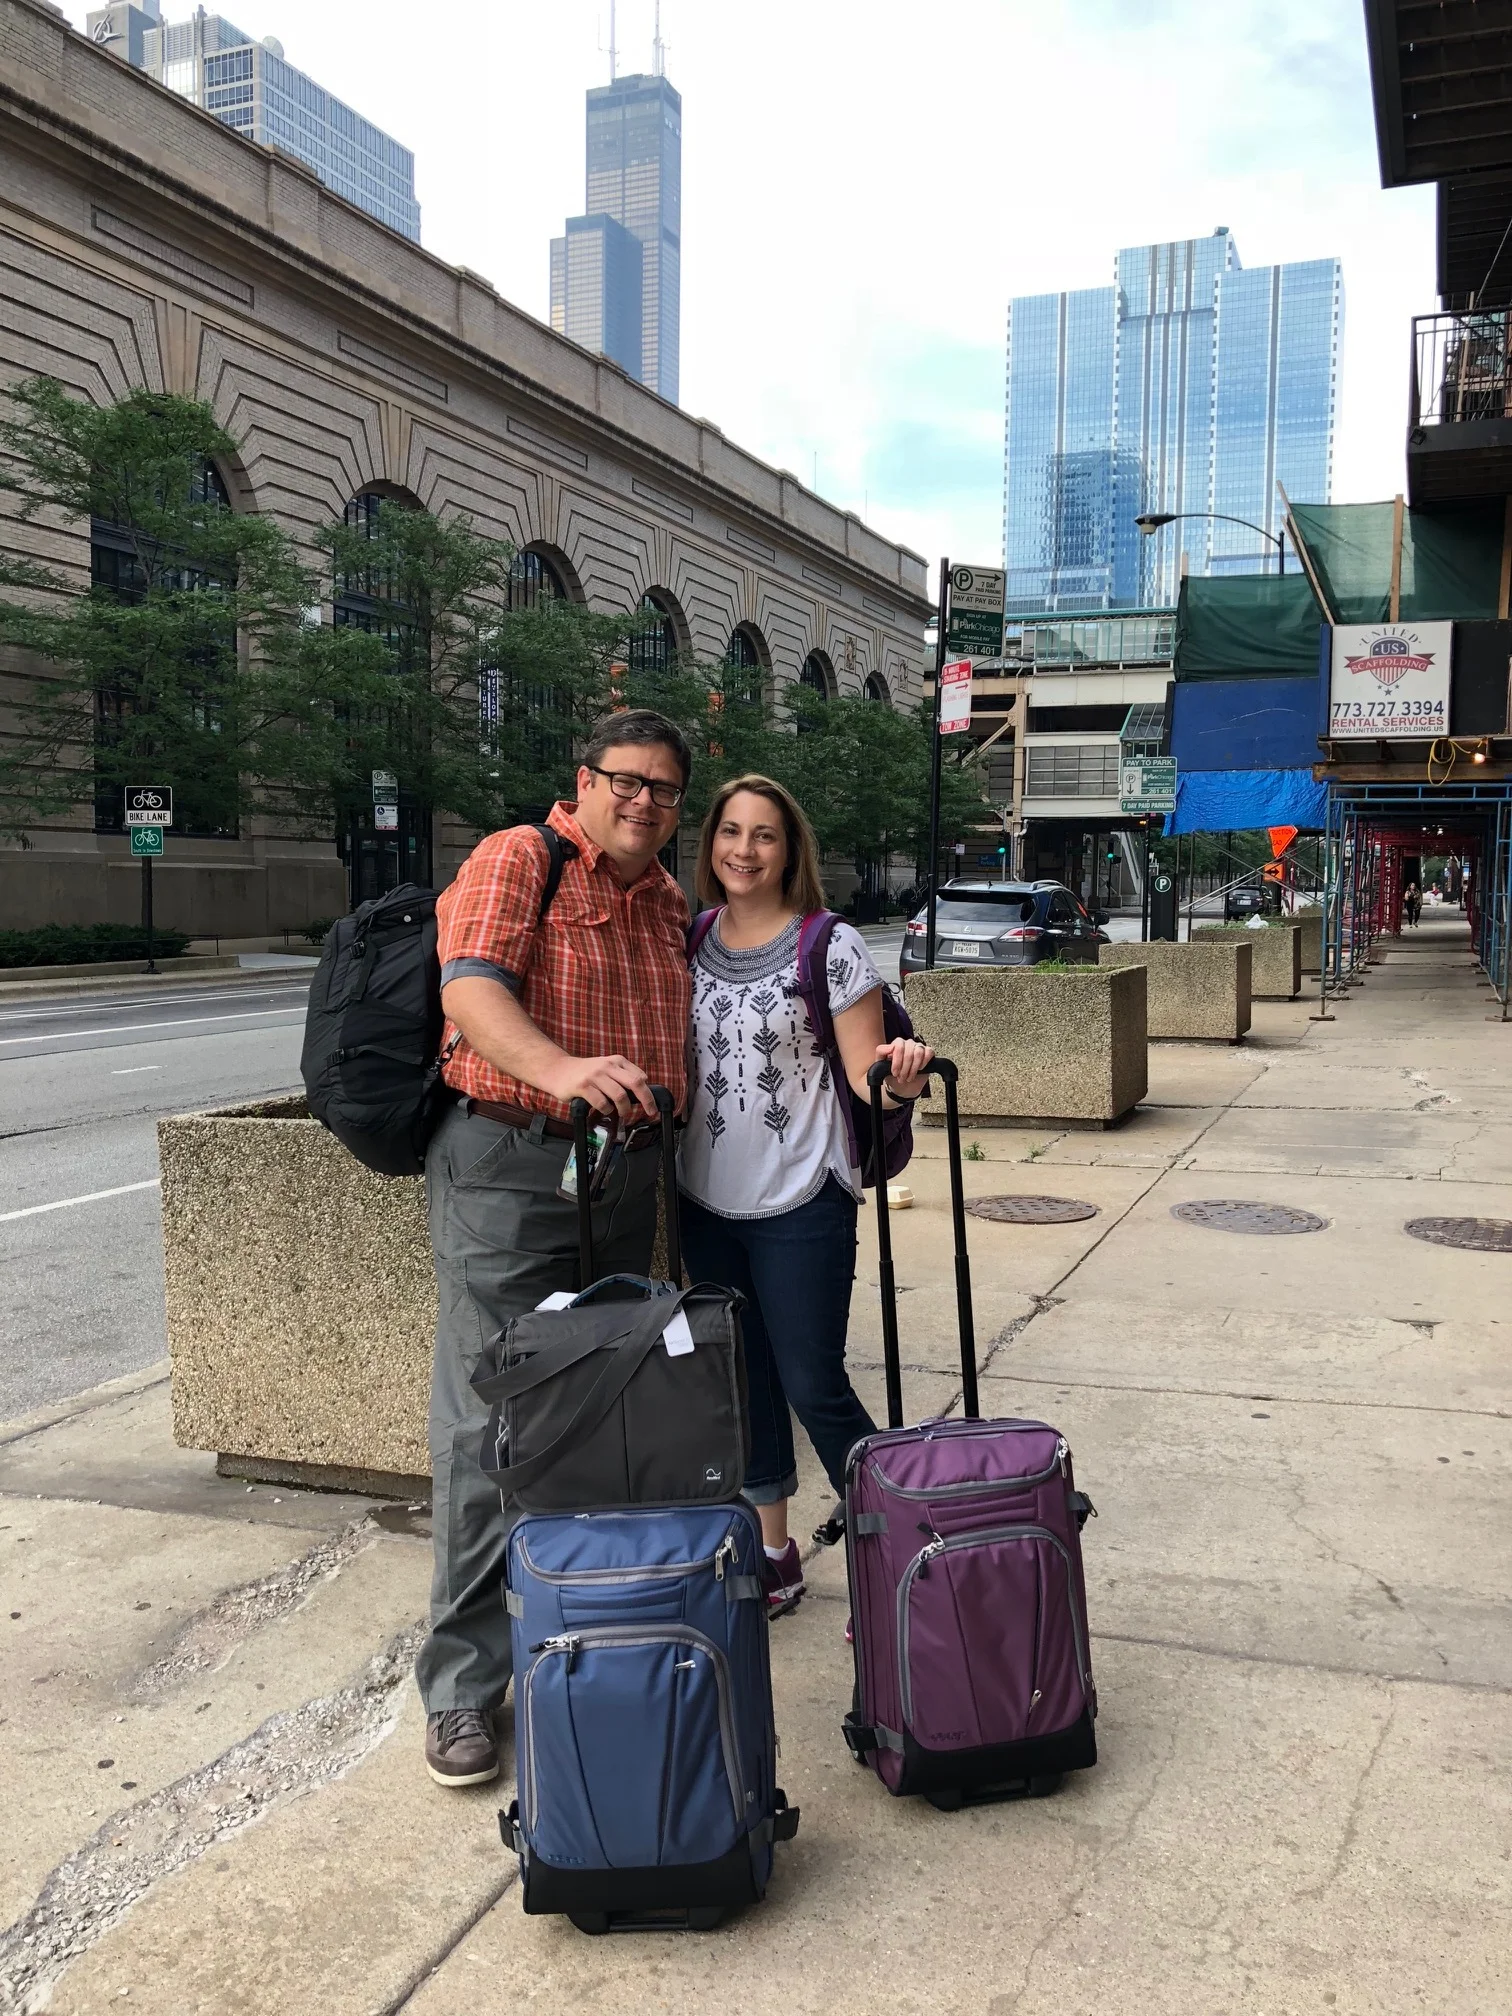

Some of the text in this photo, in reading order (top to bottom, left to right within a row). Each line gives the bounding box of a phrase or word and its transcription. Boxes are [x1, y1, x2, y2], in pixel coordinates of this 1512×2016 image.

[986, 581, 997, 589] DAY
[953, 594, 1001, 606] PAY AT PAY BOX
[959, 618, 1001, 635] ParkChicago
[1361, 627, 1419, 645] UNITED
[963, 644, 979, 654] 261
[980, 646, 995, 656] 401
[1380, 642, 1399, 655] US
[1351, 657, 1427, 673] SCAFFOLDING
[1332, 700, 1444, 718] 773.727.3394
[941, 718, 968, 732] TOW ZONE
[1331, 716, 1444, 728] RENTAL SERVICES
[1331, 725, 1444, 734] WWW.UNITEDSCAFFOLDING.US
[129, 812, 168, 821] BIKE LANE
